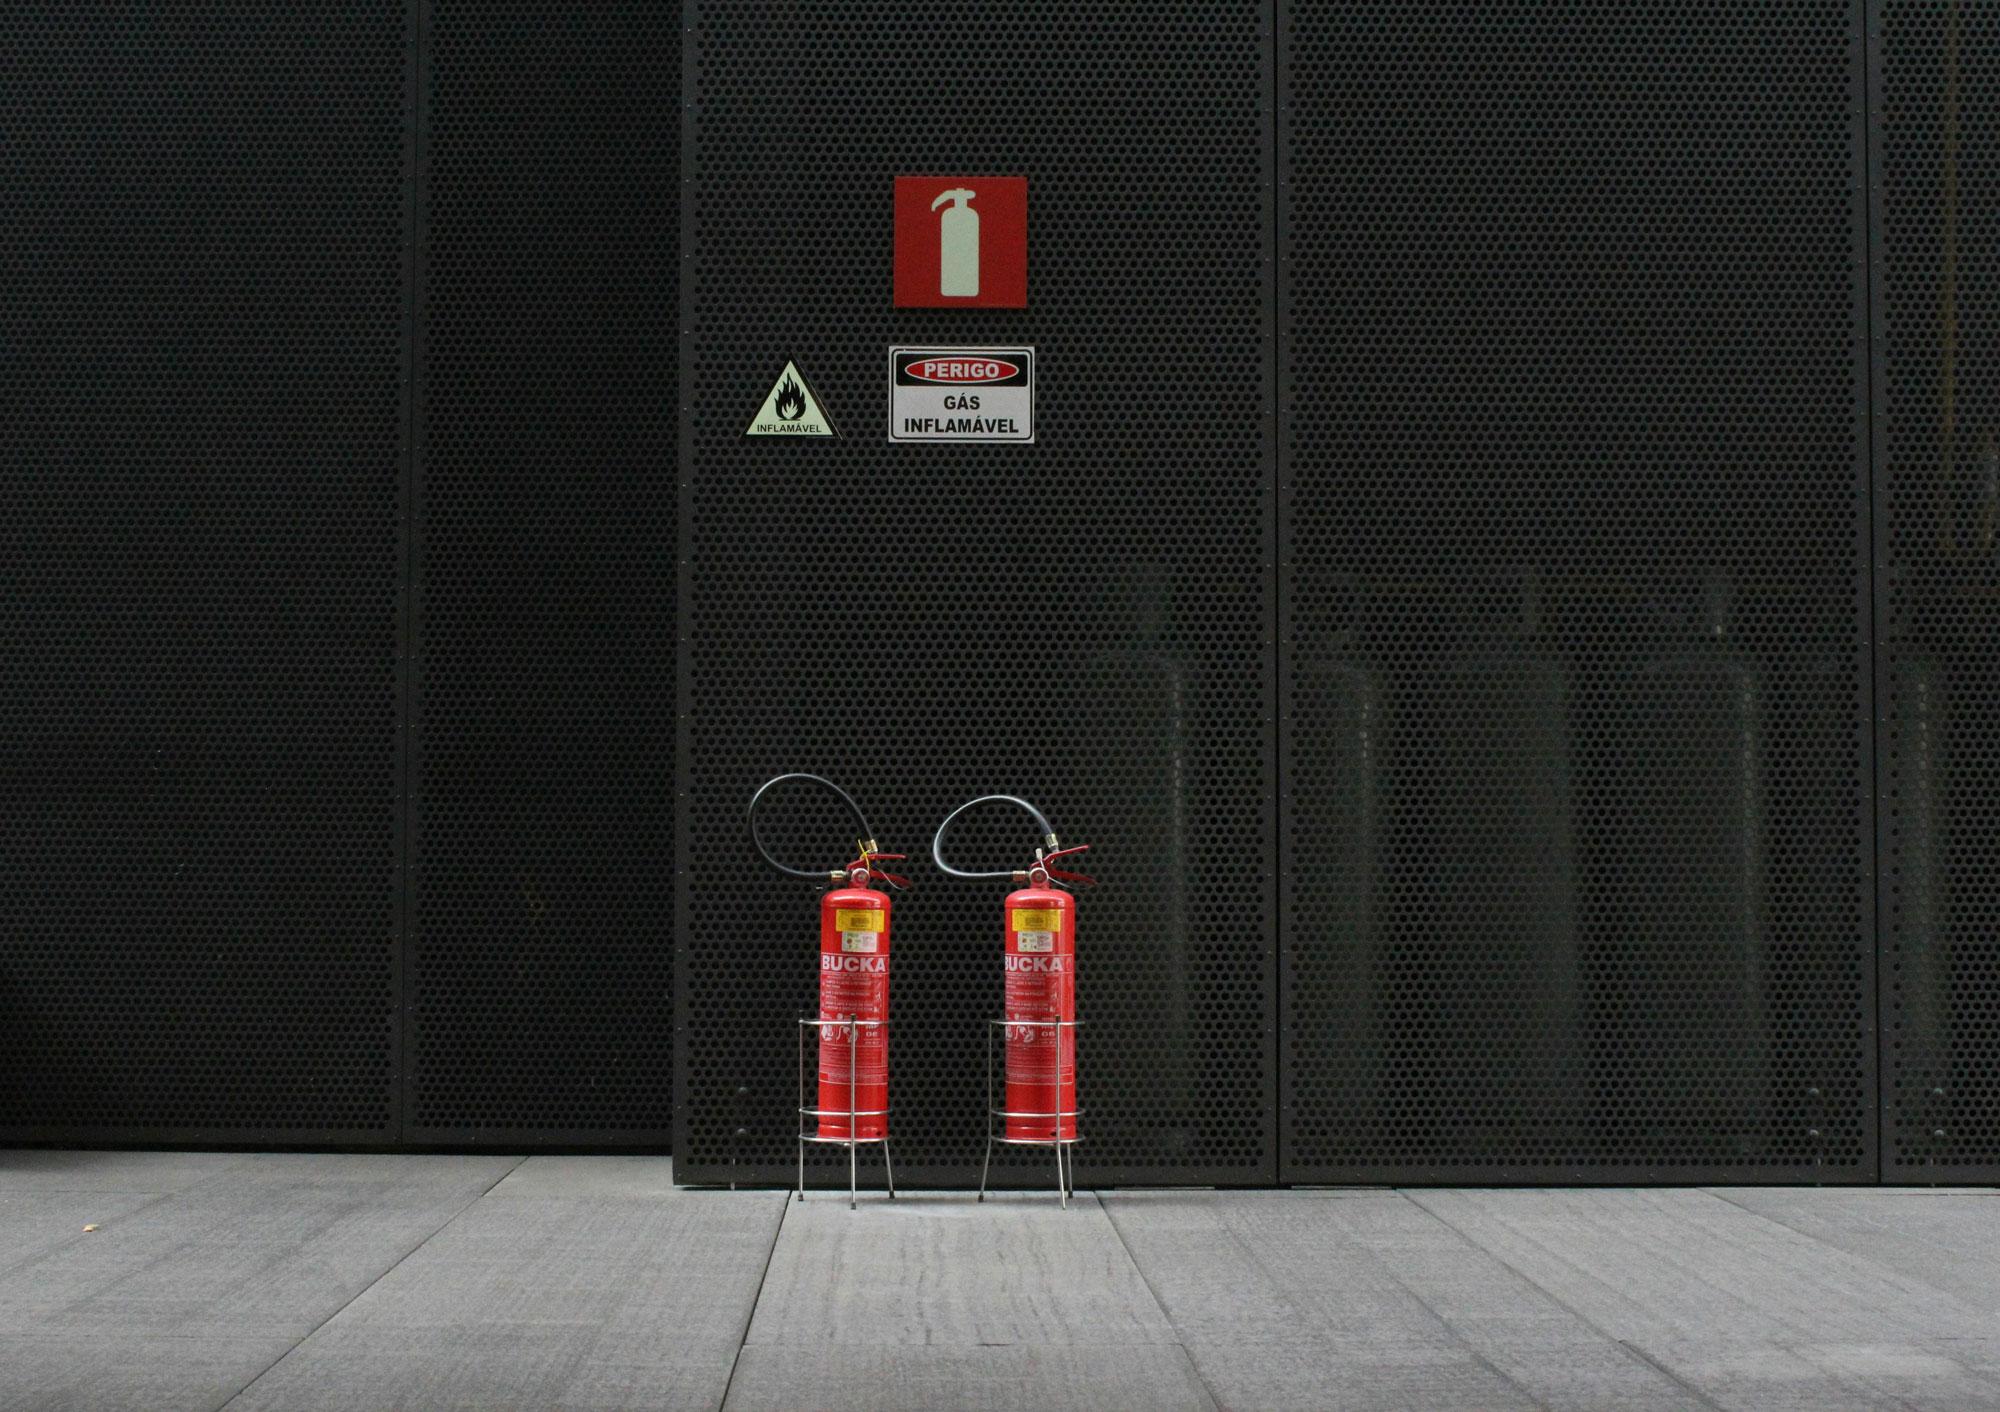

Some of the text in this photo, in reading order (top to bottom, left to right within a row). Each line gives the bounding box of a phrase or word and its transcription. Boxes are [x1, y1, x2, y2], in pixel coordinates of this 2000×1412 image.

[924, 362, 1000, 378] PERIGO
[943, 393, 981, 410] GÁS
[757, 422, 822, 433] INFLAMÁVEL
[904, 416, 1019, 433] INFLAMÁVEL
[822, 954, 886, 972] BUCKA
